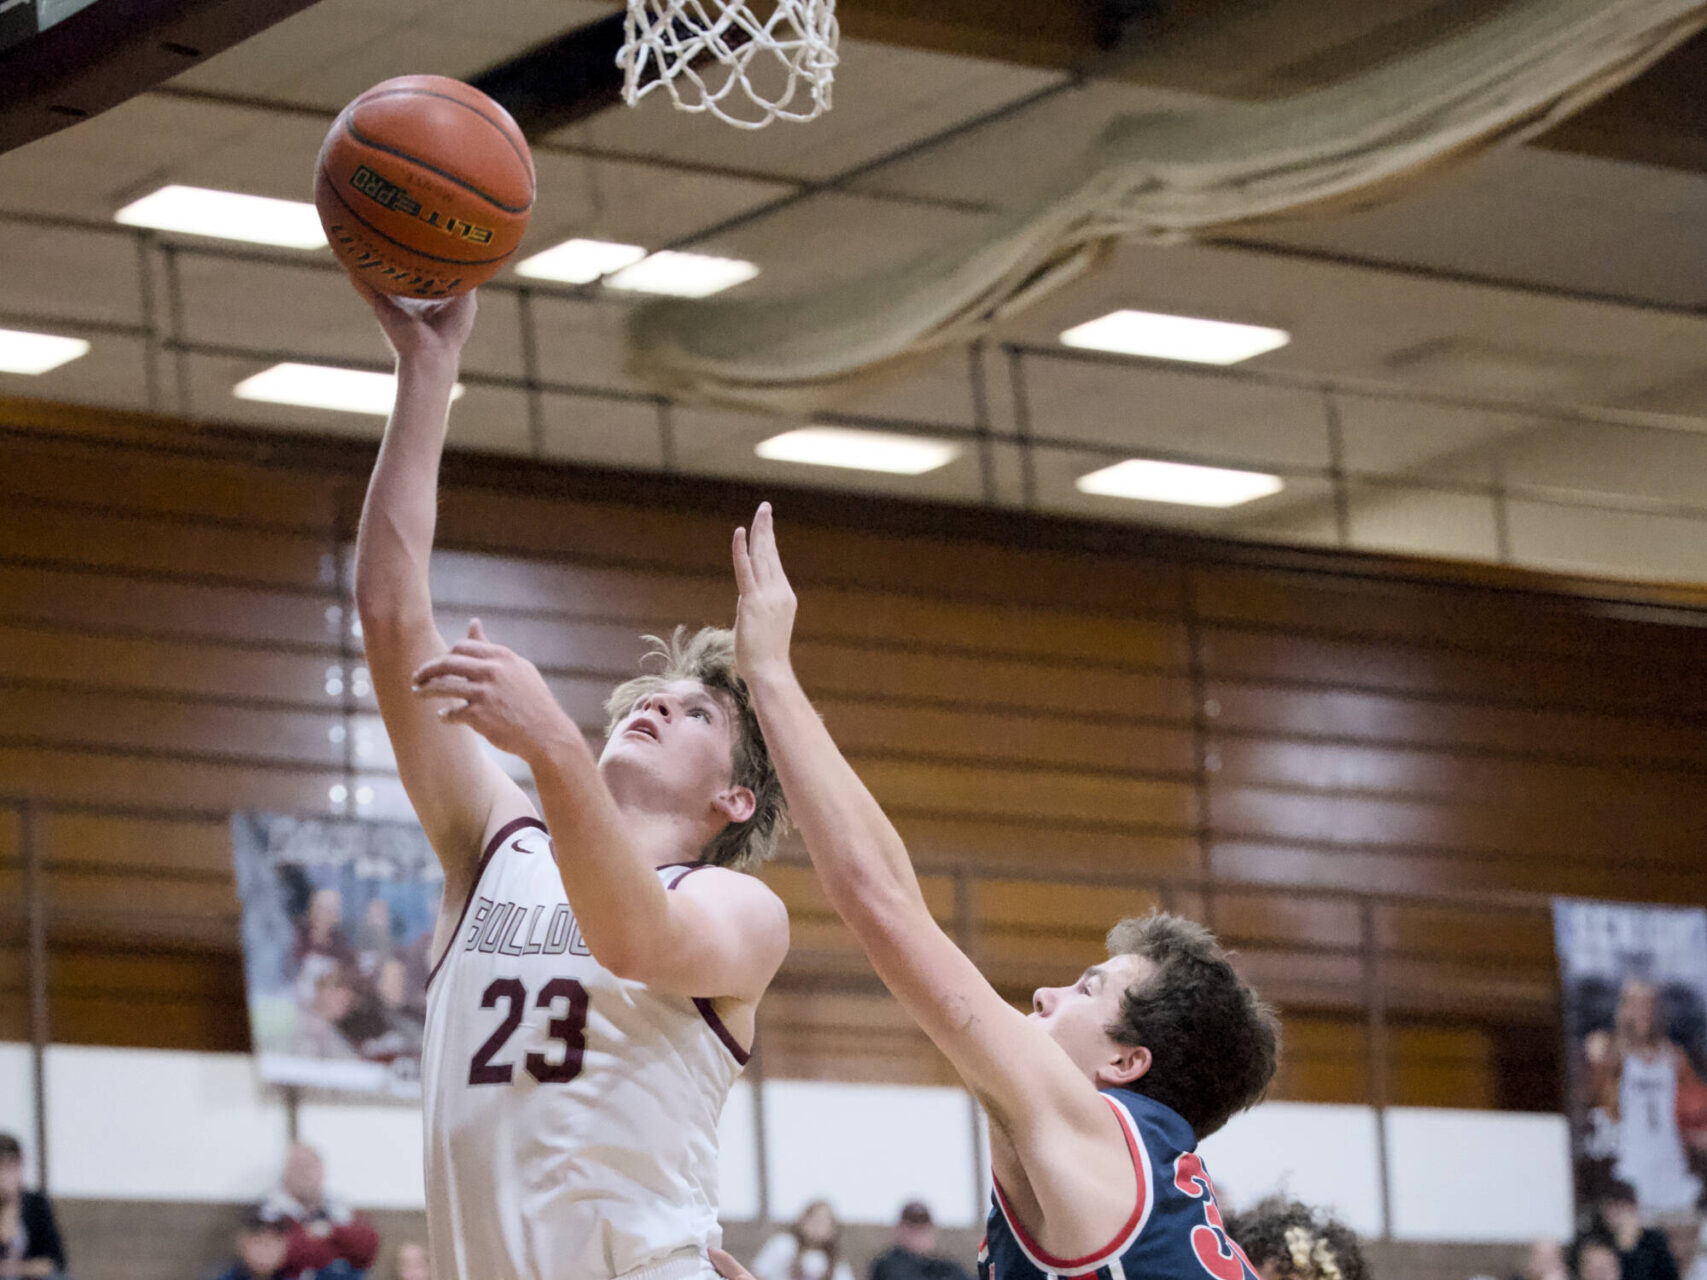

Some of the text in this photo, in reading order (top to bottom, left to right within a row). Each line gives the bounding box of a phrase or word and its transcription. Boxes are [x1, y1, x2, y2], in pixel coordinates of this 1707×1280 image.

[351, 166, 397, 206] PRO
[394, 190, 493, 243] ELITE
[467, 977, 592, 1085] 23
